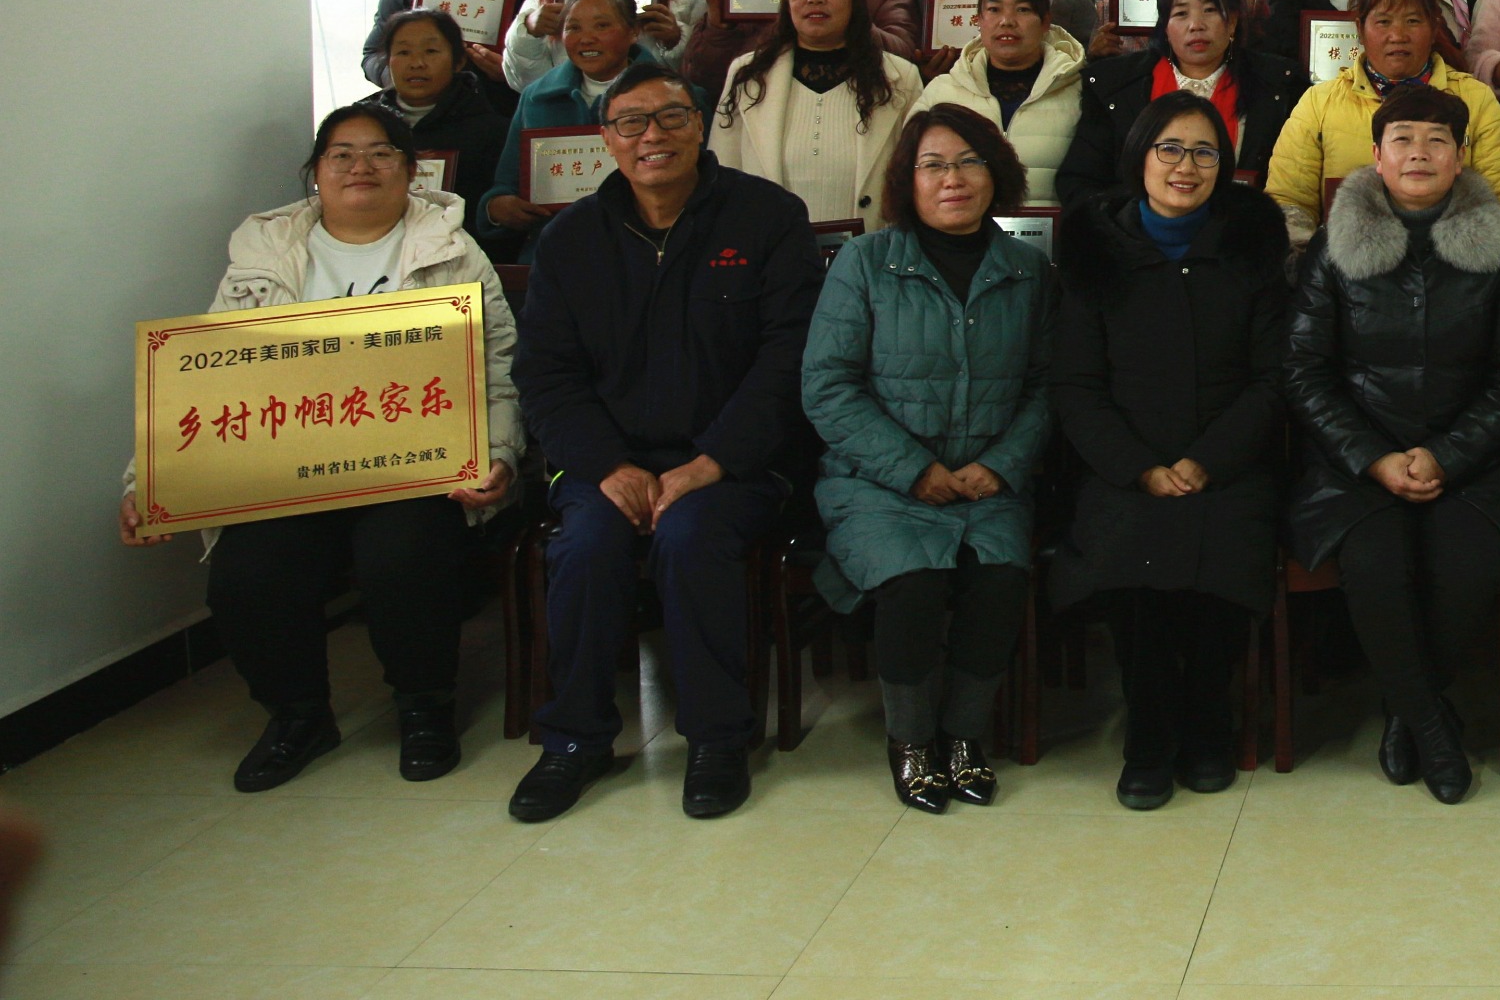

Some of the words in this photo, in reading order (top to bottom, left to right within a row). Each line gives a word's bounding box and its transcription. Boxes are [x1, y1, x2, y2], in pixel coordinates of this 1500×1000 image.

[550, 160, 603, 176] 模范户
[177, 376, 453, 452] 乡村巾帼农家乐
[297, 447, 447, 479] 贵州省妇女联合会颁发
